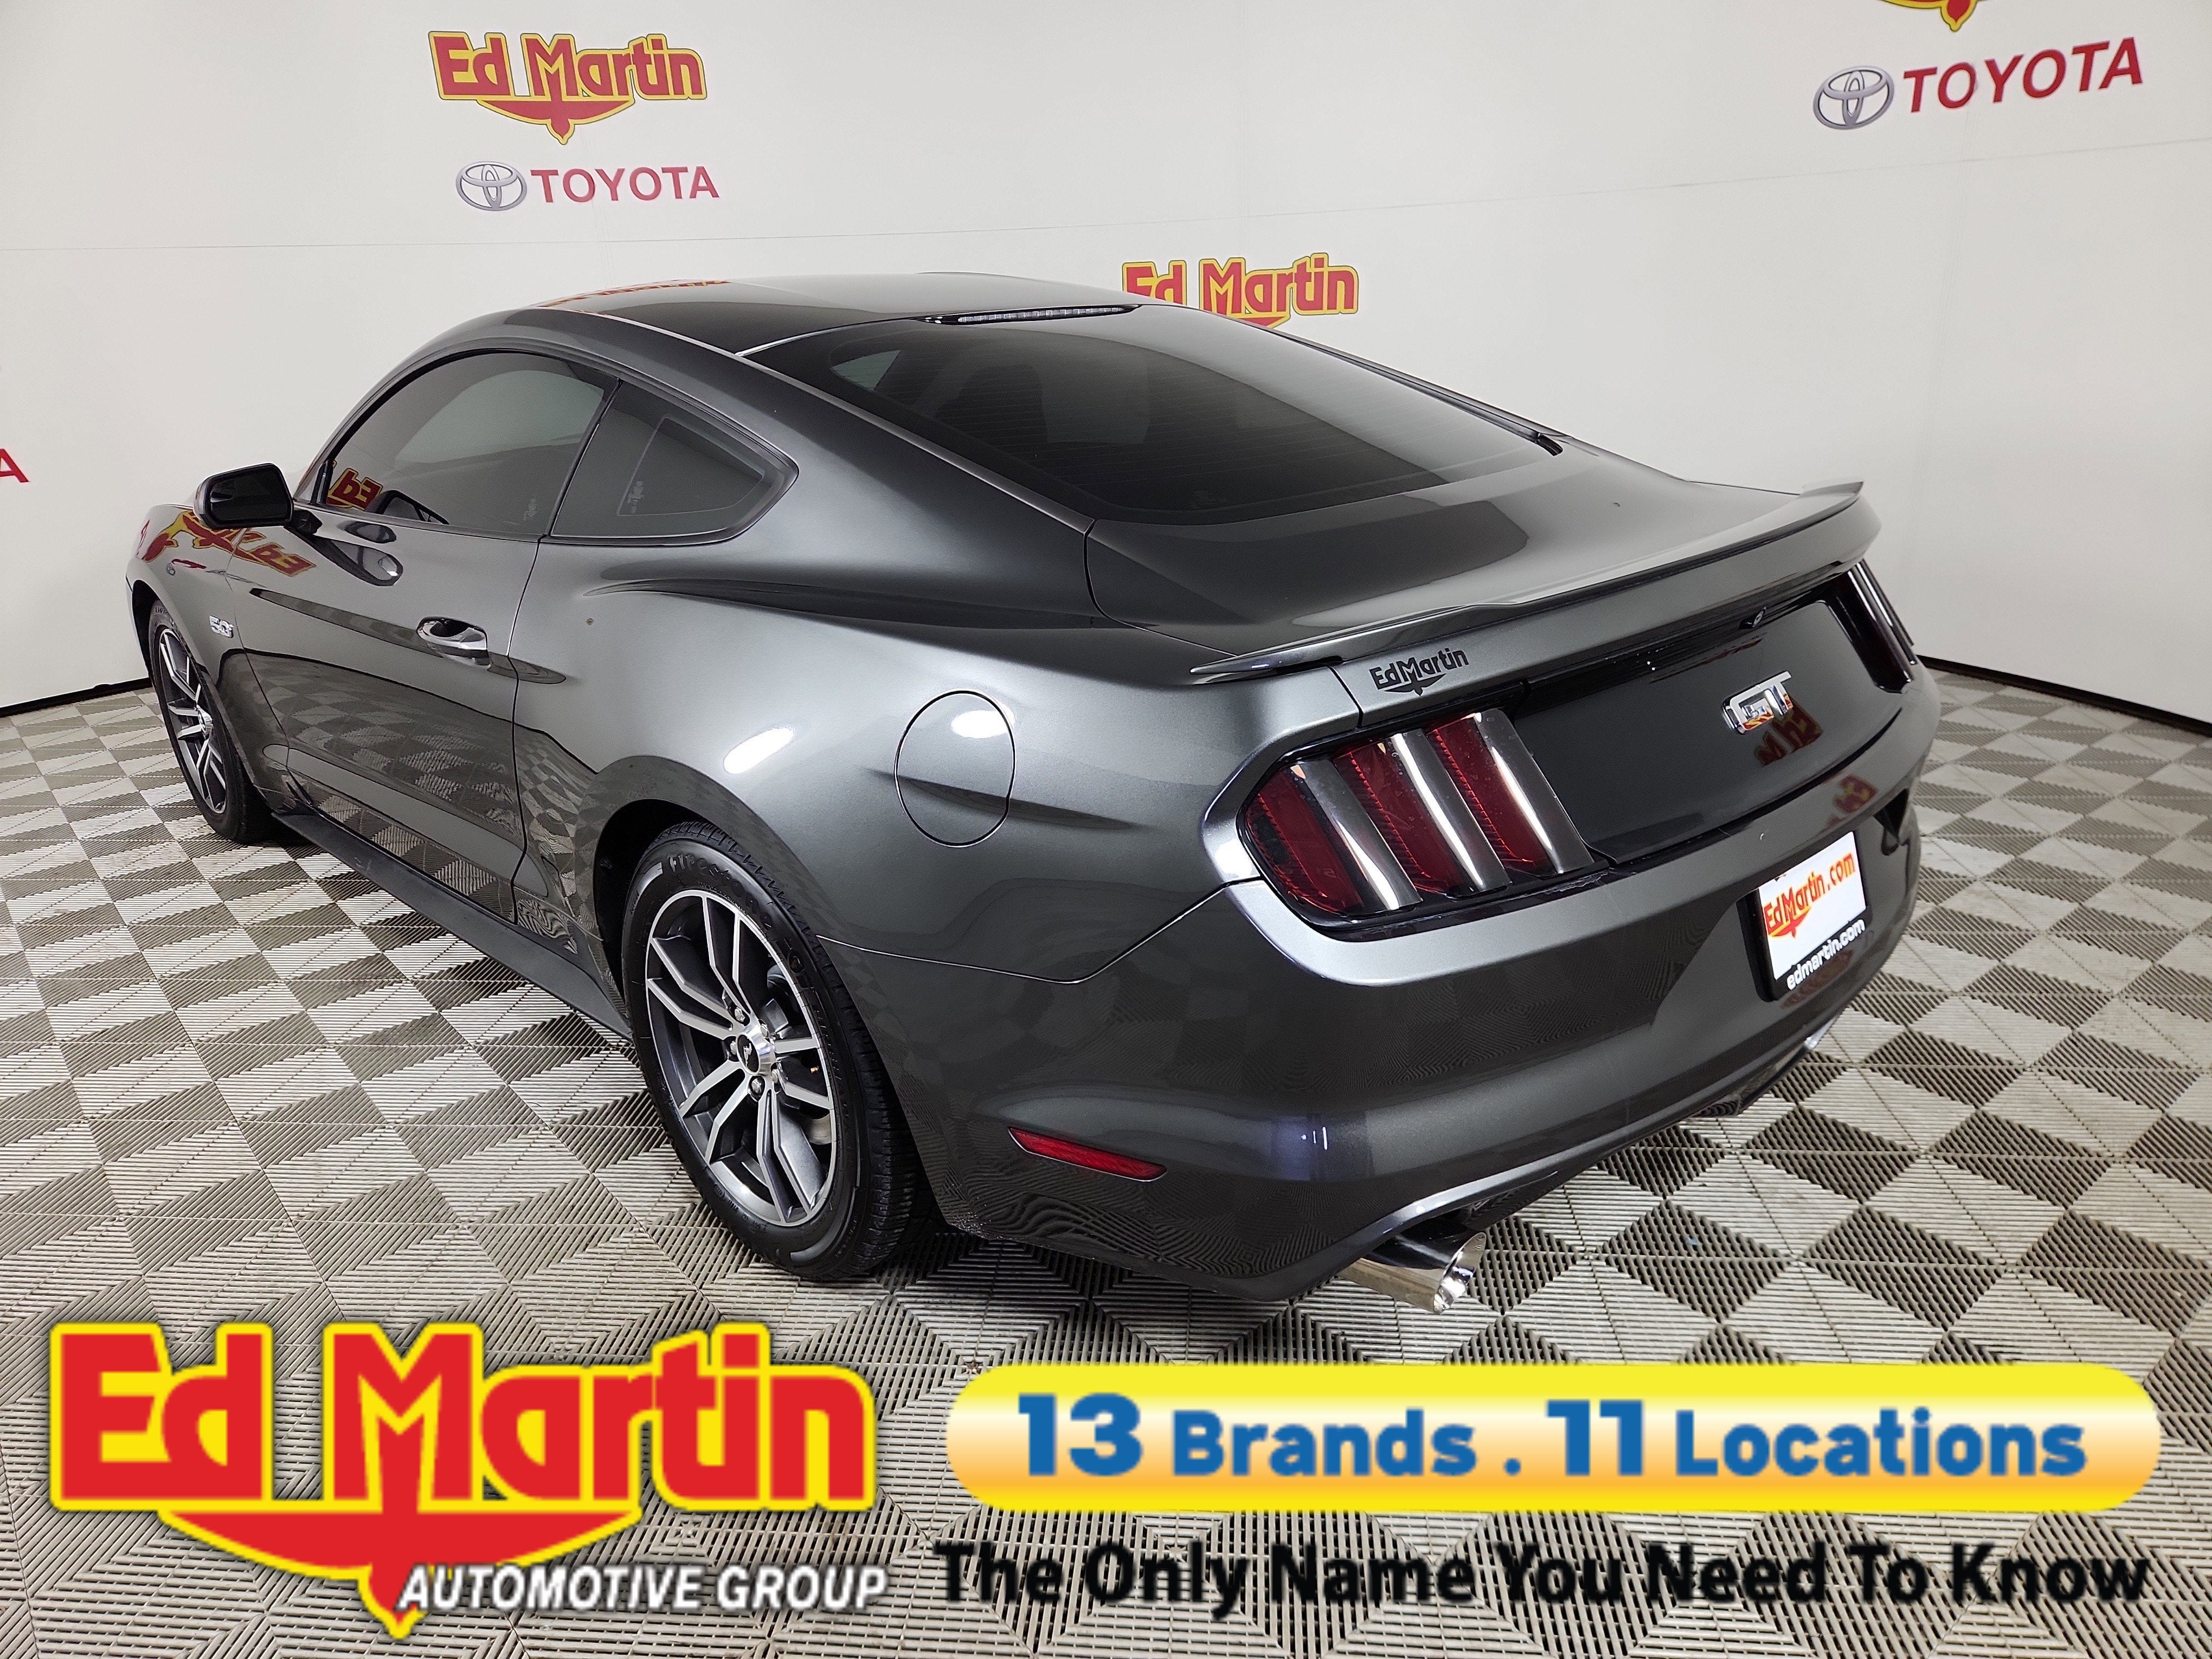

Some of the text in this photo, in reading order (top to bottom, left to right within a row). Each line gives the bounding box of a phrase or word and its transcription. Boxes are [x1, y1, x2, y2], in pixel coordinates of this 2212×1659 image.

[433, 35, 703, 97] Ed Martin
[1903, 36, 2143, 113] TOYOTA
[530, 166, 720, 203] TOYOTA
[1202, 257, 1355, 314] Martin
[1368, 647, 1470, 690] EdMartin
[1722, 670, 1792, 734] GT
[1763, 852, 1856, 937] EdMartin.com
[1786, 918, 1866, 991] edmartin.com
